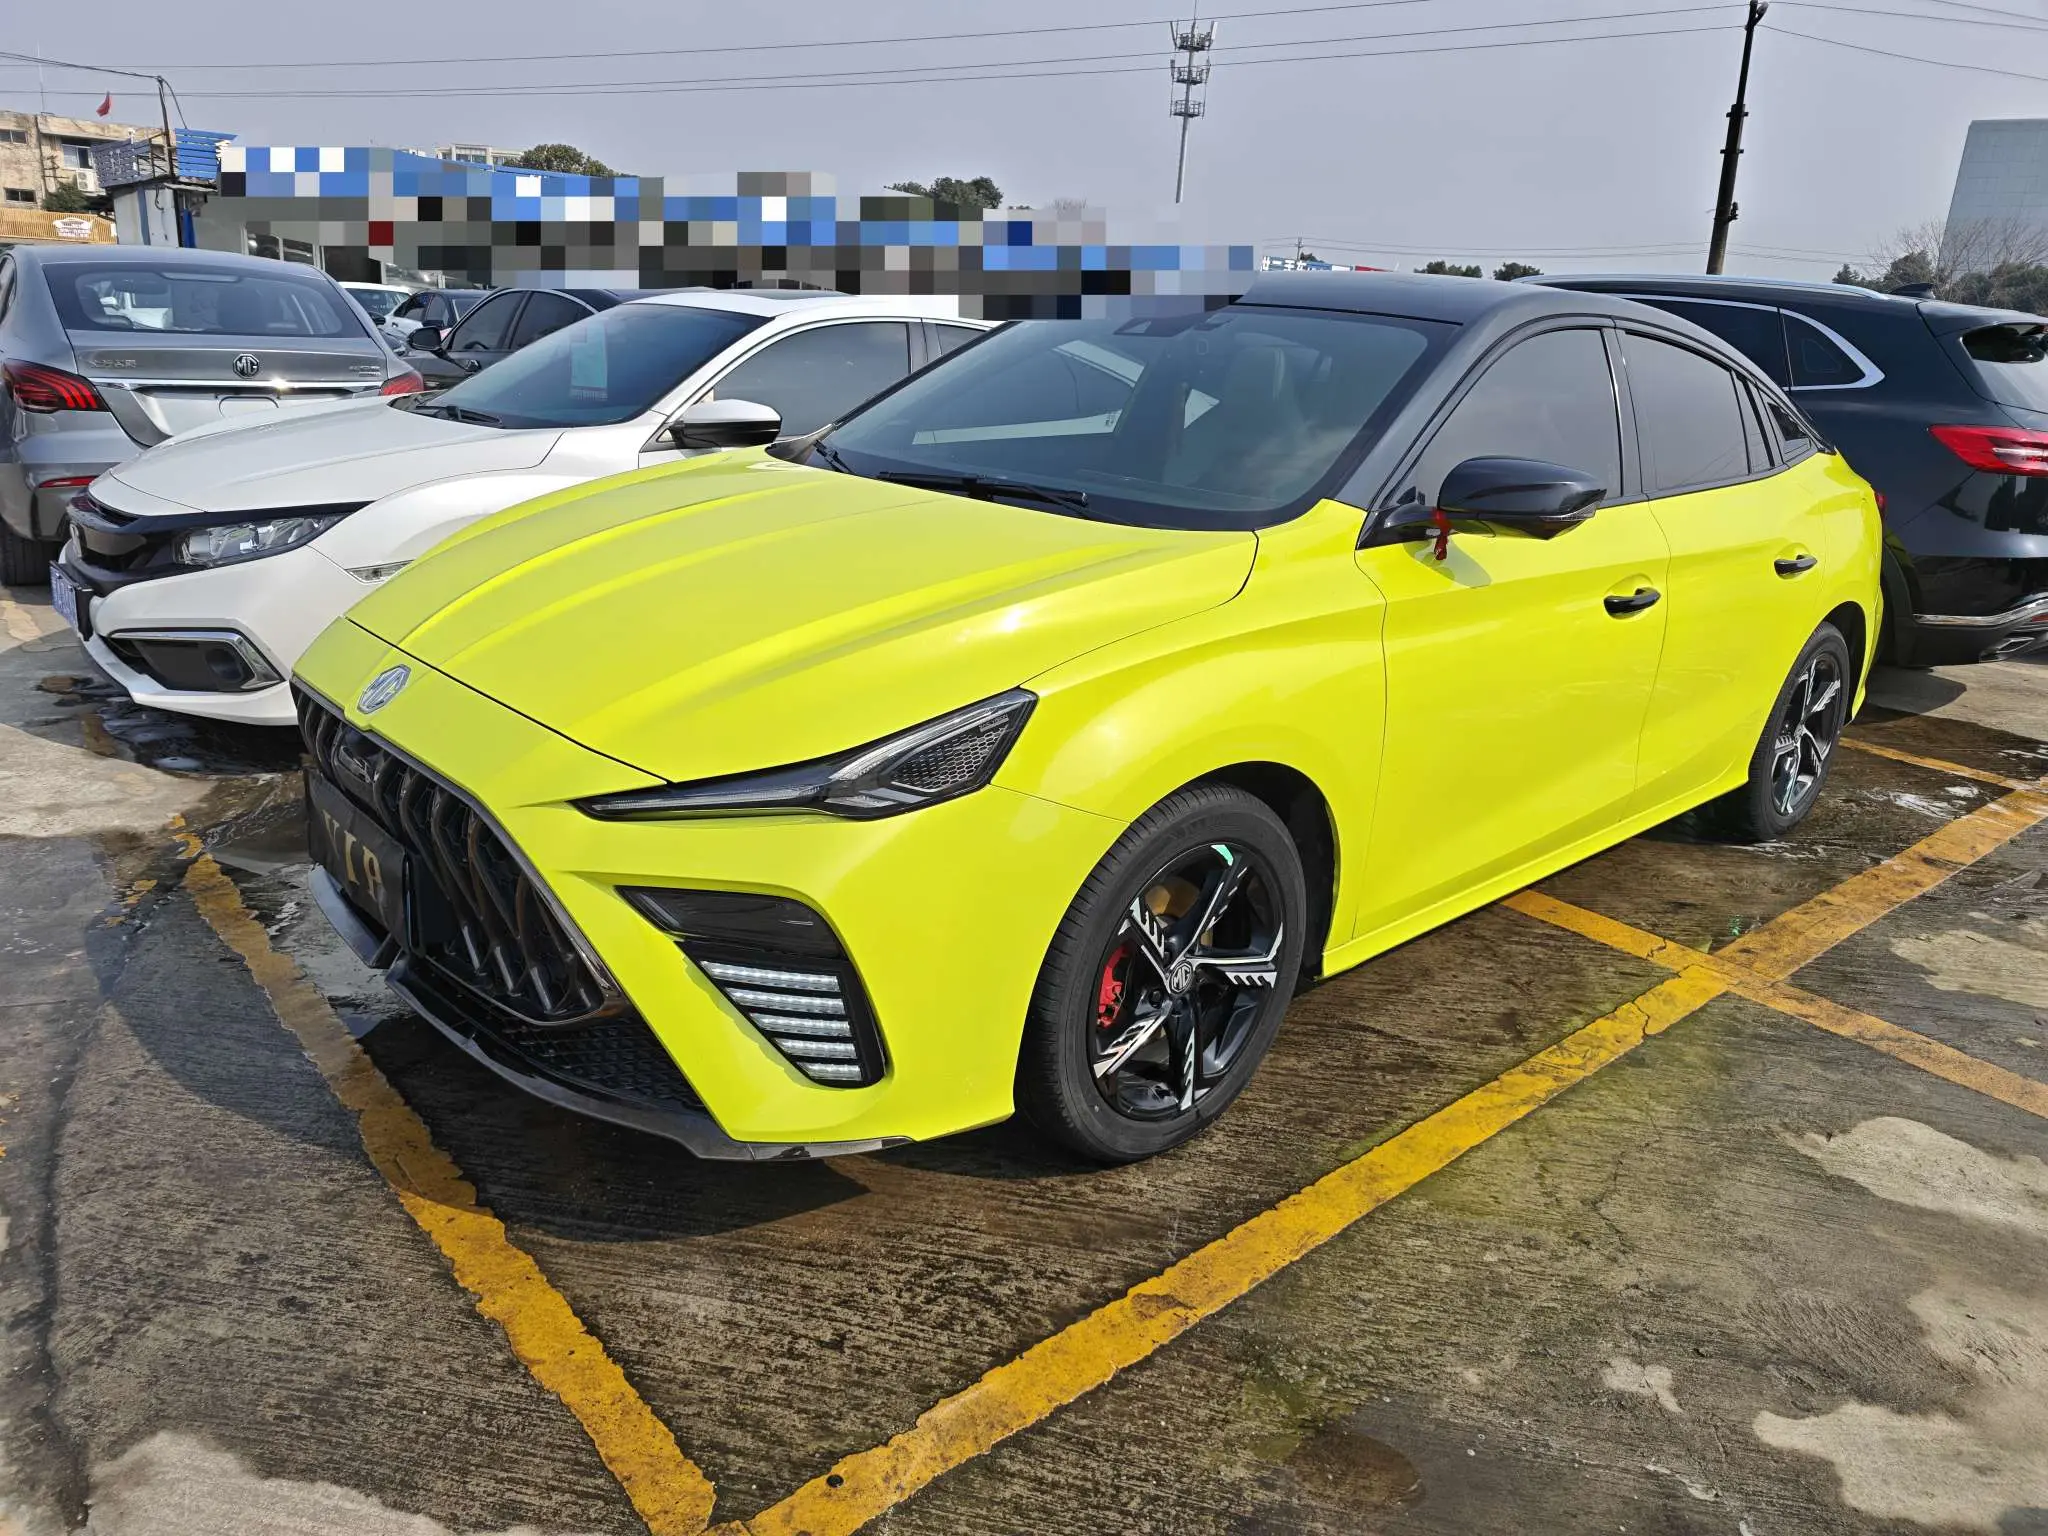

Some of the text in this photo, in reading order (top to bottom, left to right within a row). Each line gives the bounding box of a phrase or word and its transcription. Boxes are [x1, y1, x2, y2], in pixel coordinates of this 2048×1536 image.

[235, 355, 259, 378] MG
[360, 666, 408, 710] MG
[1172, 963, 1191, 991] MG
